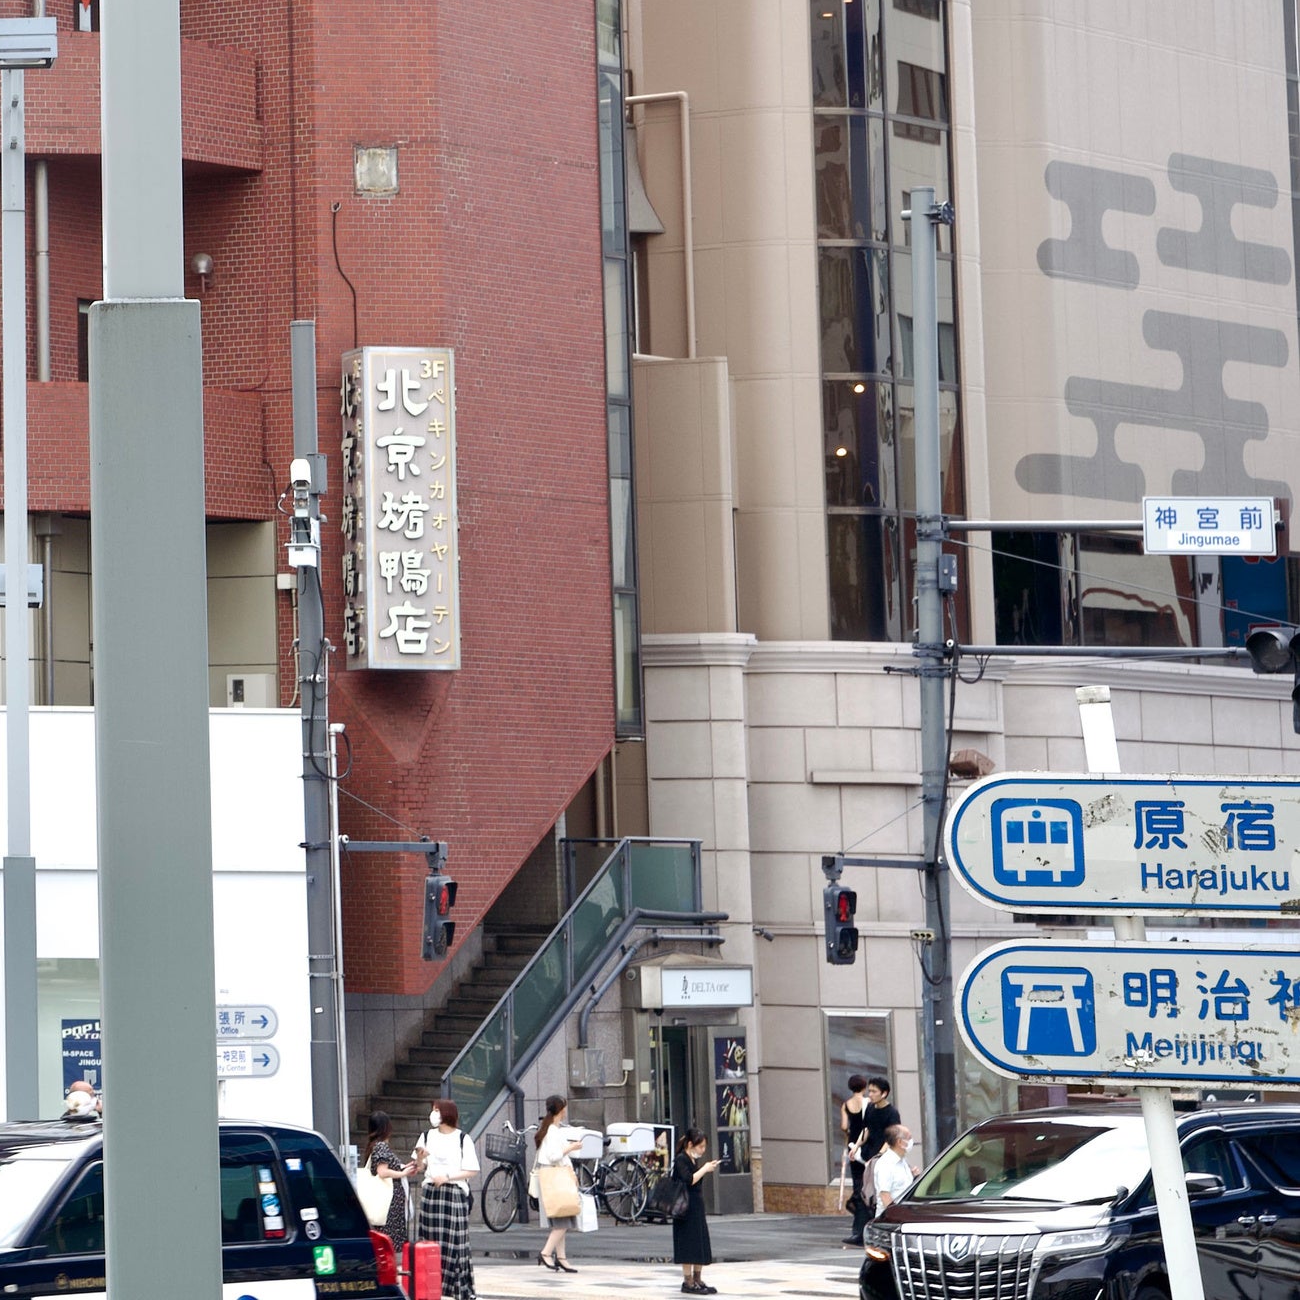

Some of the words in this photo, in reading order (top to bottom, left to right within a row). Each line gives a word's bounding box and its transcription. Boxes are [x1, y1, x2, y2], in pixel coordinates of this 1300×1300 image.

[420, 359, 445, 379] 3F
[376, 367, 432, 655] 北京烤鴨店
[1154, 506, 1262, 531] 神宮前
[1178, 533, 1241, 548] Jingumae
[1133, 800, 1276, 851] 原宿
[1141, 863, 1290, 896] Harajuku
[691, 982, 716, 993] DELTA
[61, 1022, 93, 1039] POP
[220, 1027, 239, 1035] Office
